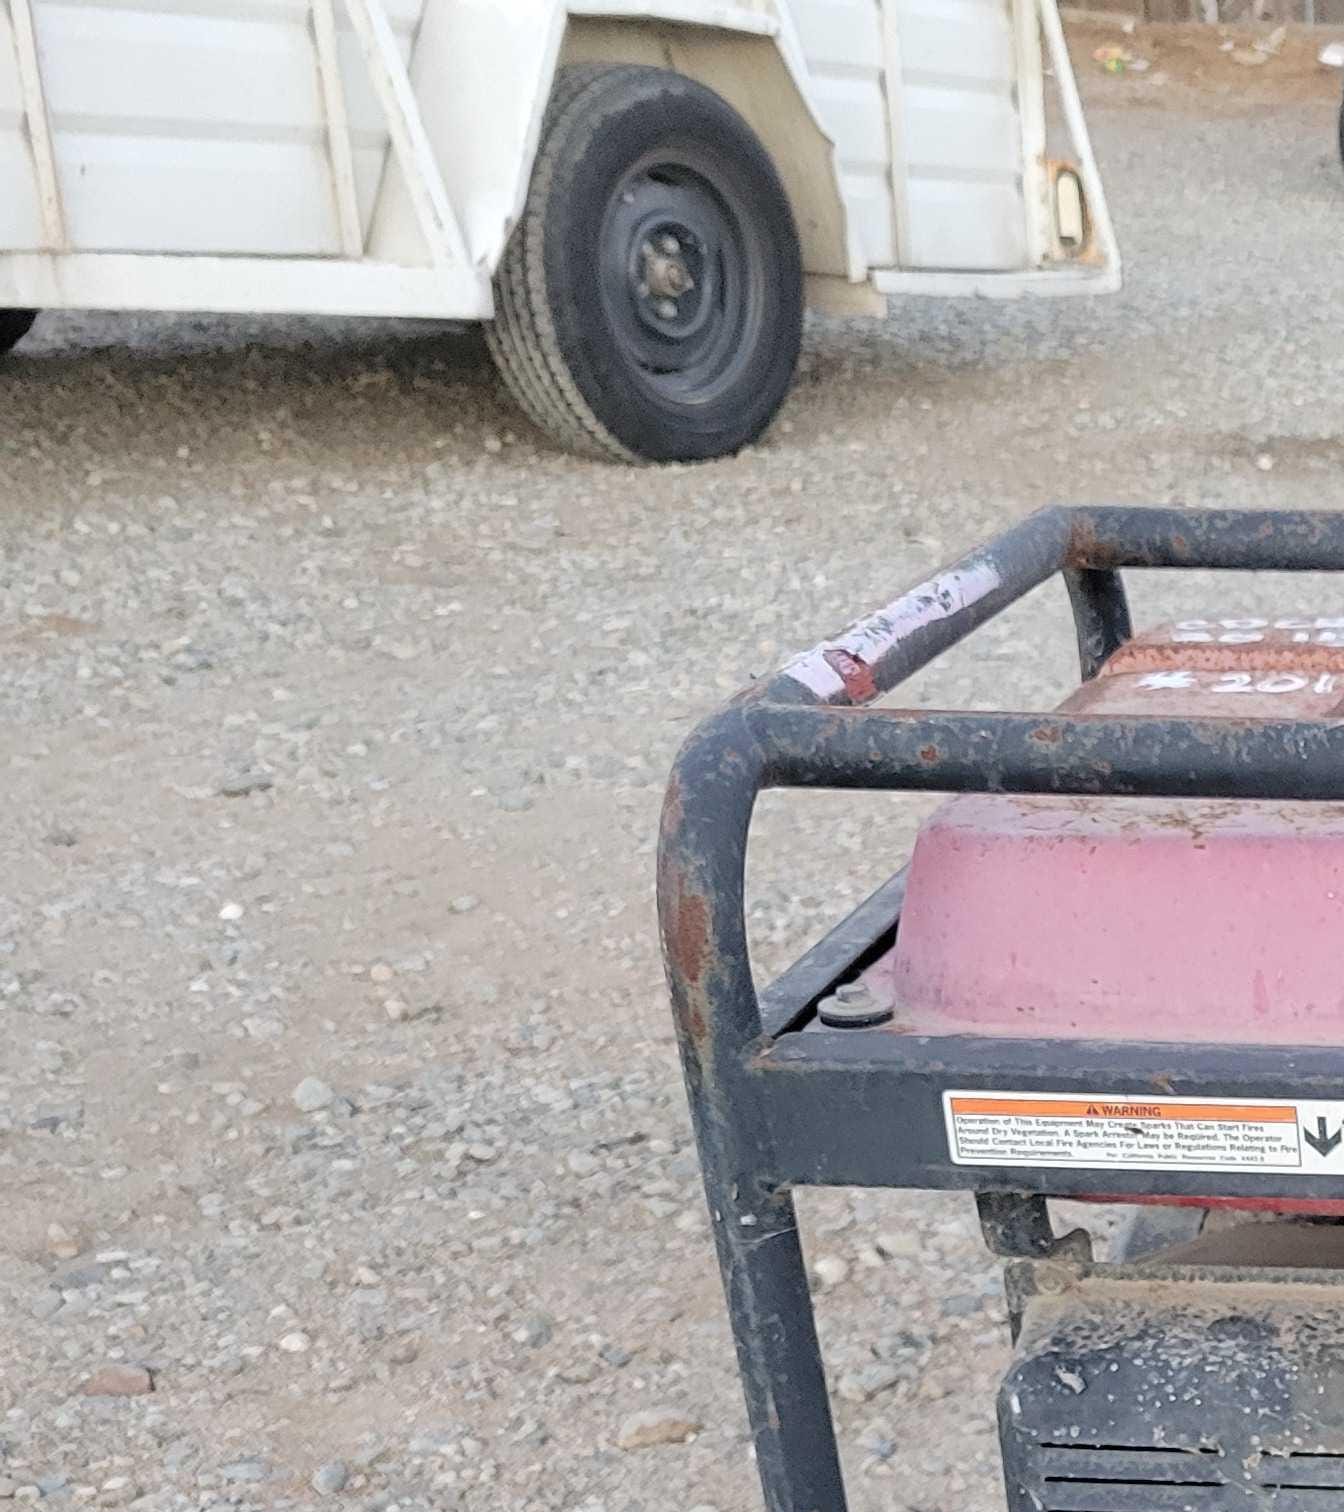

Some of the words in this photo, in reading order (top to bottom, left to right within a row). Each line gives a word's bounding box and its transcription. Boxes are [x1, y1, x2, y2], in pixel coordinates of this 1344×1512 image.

[1102, 1105, 1161, 1117] WARNING
[956, 1116, 1000, 1127] Operation
[1004, 1118, 1012, 1126] of
[1015, 1118, 1033, 1127] This
[1036, 1119, 1083, 1129] Equipment
[1086, 1120, 1105, 1130] May
[1108, 1120, 1137, 1130] Create
[1141, 1121, 1172, 1132] Sparks
[1175, 1122, 1195, 1131] That
[1197, 1122, 1215, 1131] Can
[1217, 1123, 1240, 1132] Start
[1242, 1123, 1265, 1133] Fires
[957, 1127, 989, 1136] Around
[992, 1128, 1008, 1138] Dry
[1064, 1129, 1071, 1138] A
[1073, 1129, 1100, 1140] Spark
[1143, 1132, 1162, 1143] May
[1163, 1133, 1175, 1141] be
[1223, 1133, 1240, 1142] The
[1242, 1134, 1283, 1144] Operator
[959, 1136, 989, 1146] Should
[992, 1137, 1027, 1147] Contact
[1030, 1138, 1053, 1147] Local
[1056, 1139, 1073, 1148] Fire
[1076, 1139, 1118, 1150] Agencies
[1120, 1141, 1136, 1149] For
[1137, 1141, 1160, 1150] Laws
[1174, 1142, 1227, 1153] Regulations
[1230, 1144, 1266, 1154] Relating
[1280, 1145, 1298, 1154] Fire
